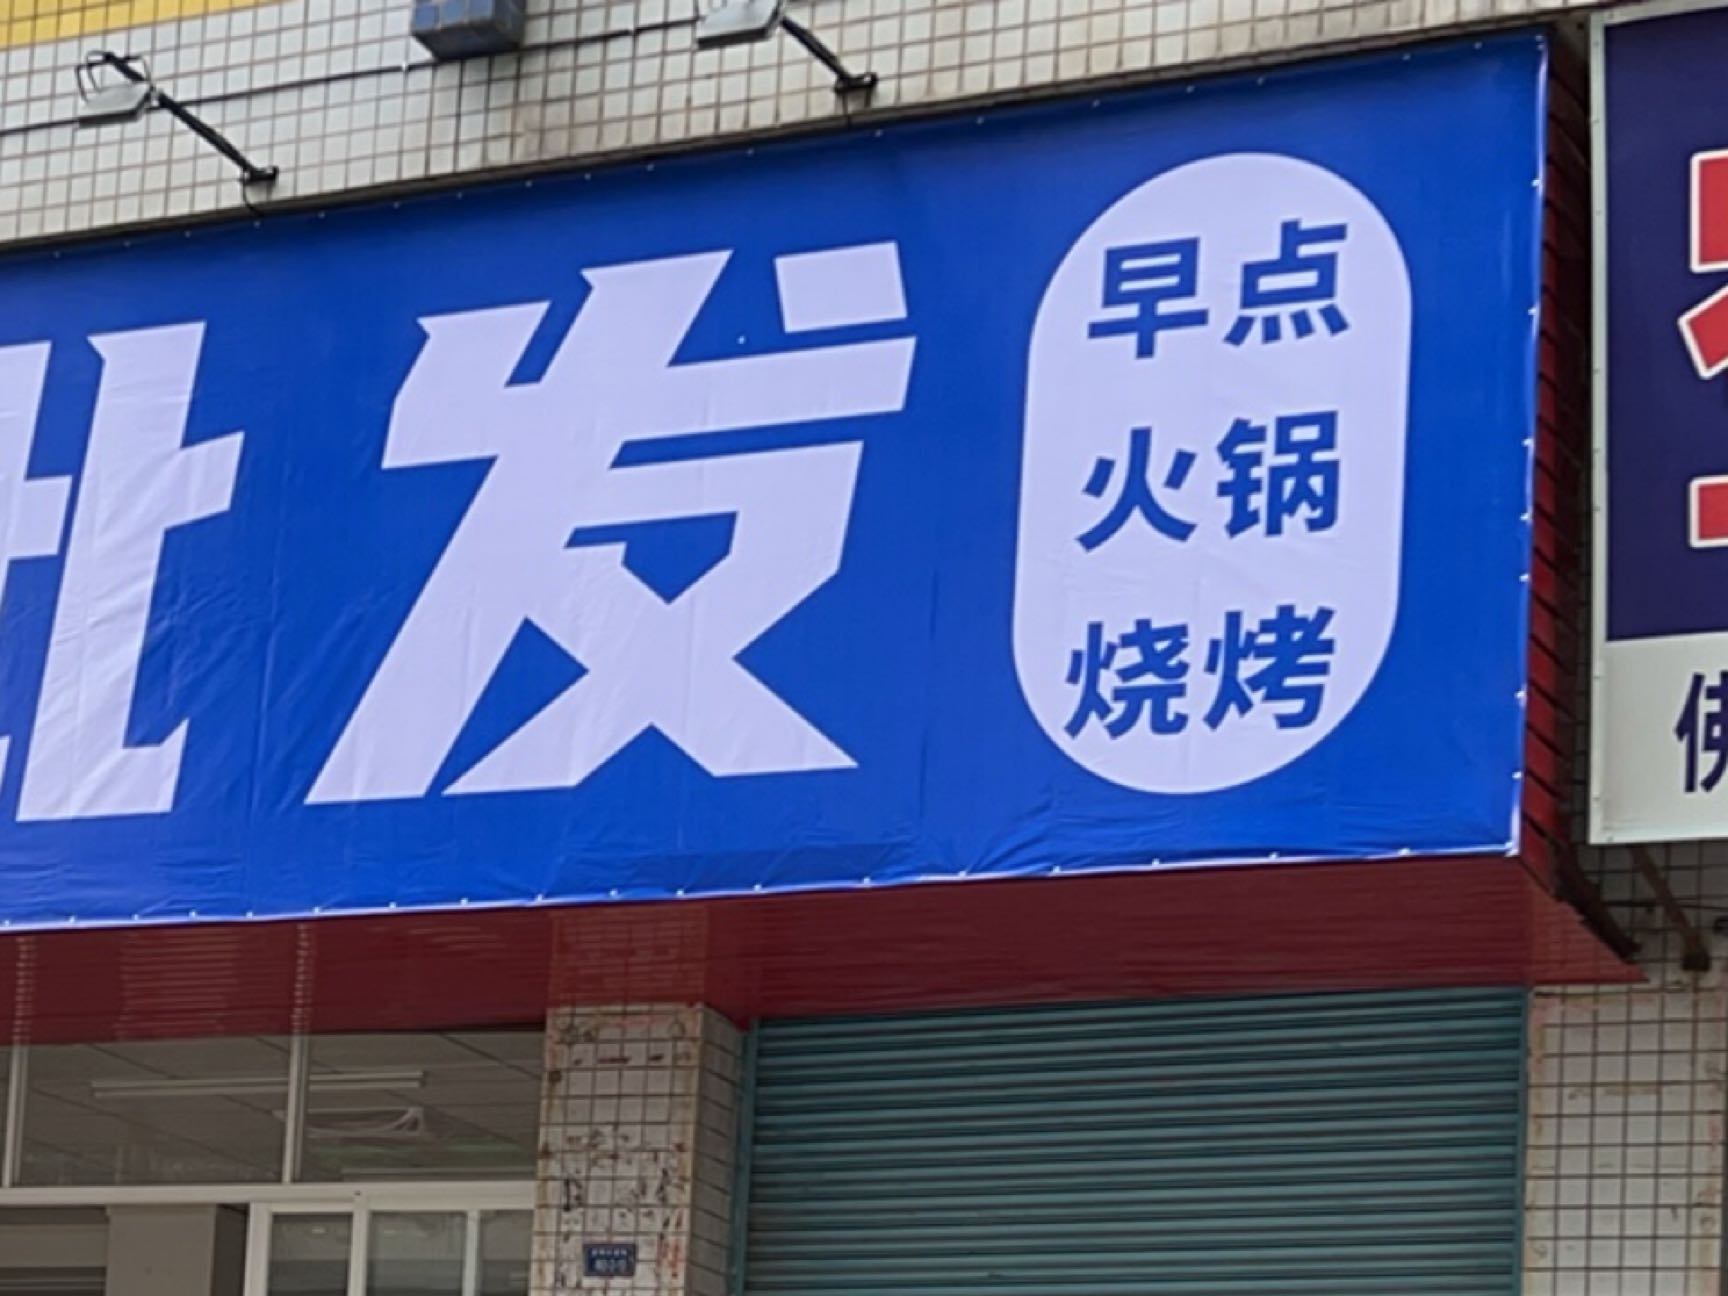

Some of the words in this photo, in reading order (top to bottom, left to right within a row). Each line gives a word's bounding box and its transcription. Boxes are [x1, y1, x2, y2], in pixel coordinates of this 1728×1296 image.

[1087, 219, 1349, 359] 早点
[1075, 411, 1339, 552] 火锅
[1064, 605, 1335, 739] 烧烤
